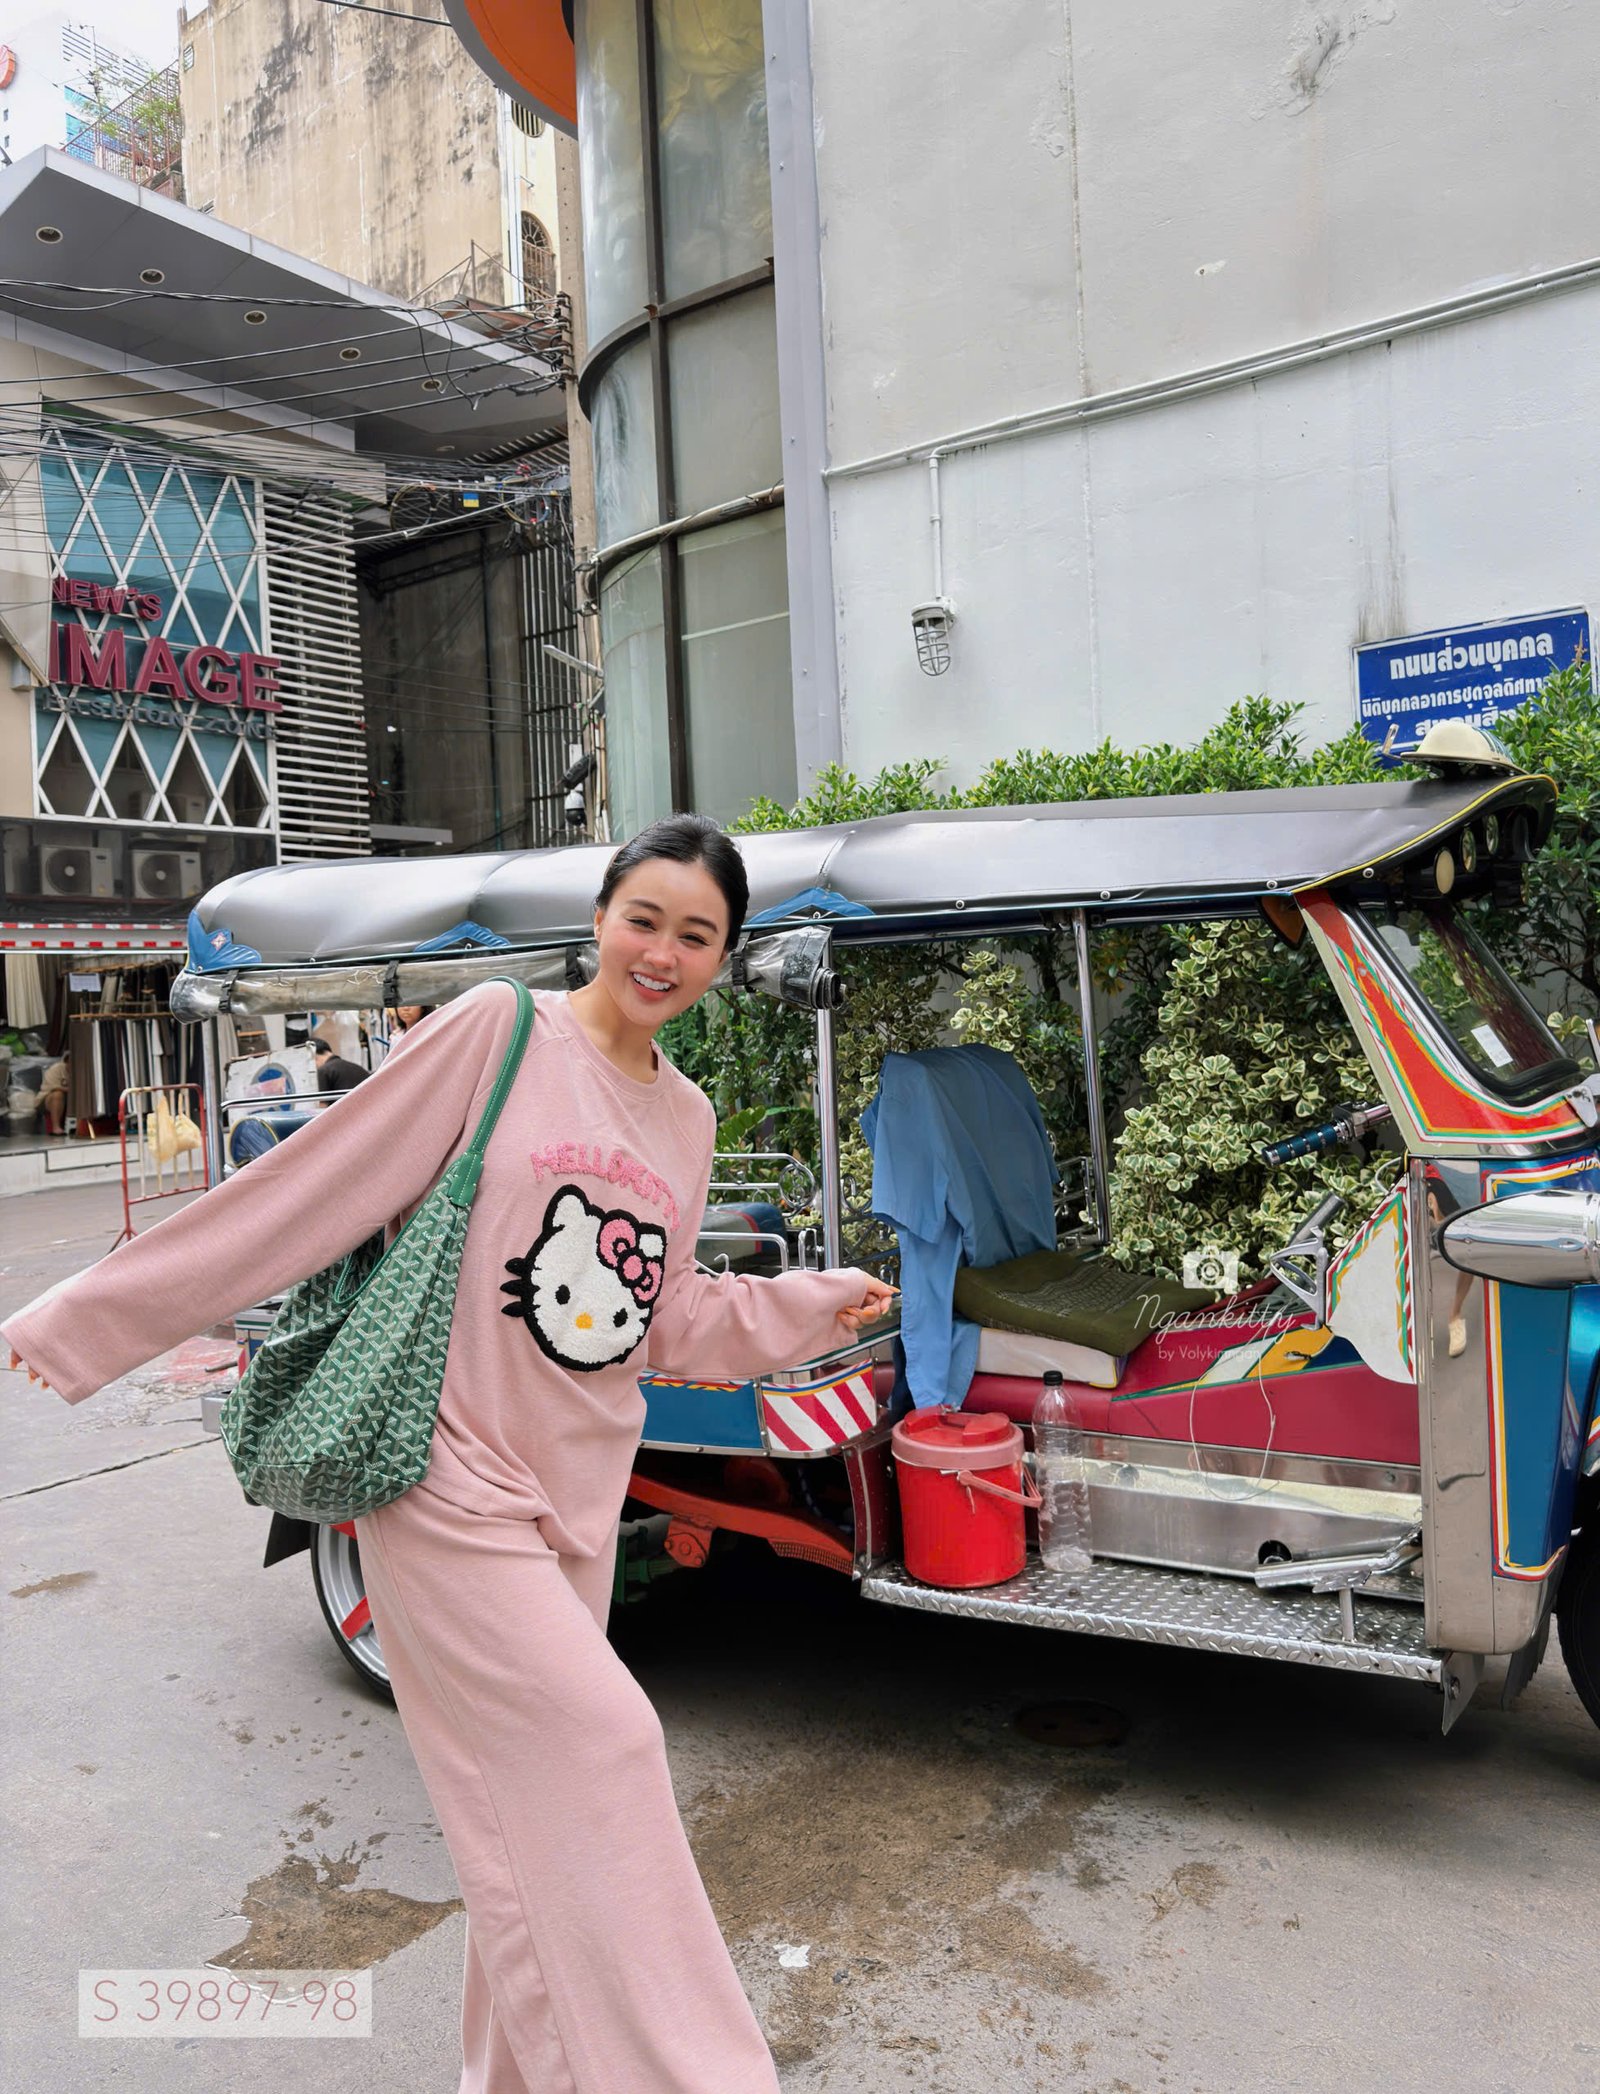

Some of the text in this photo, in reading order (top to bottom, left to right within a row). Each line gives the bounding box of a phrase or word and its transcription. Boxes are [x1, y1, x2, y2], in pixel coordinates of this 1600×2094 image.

[52, 575, 163, 621] NEW'S
[48, 620, 283, 712] IMAGE
[1390, 632, 1554, 680] ถนนส่วนบุคคล
[43, 692, 278, 741] FASHION ZONE
